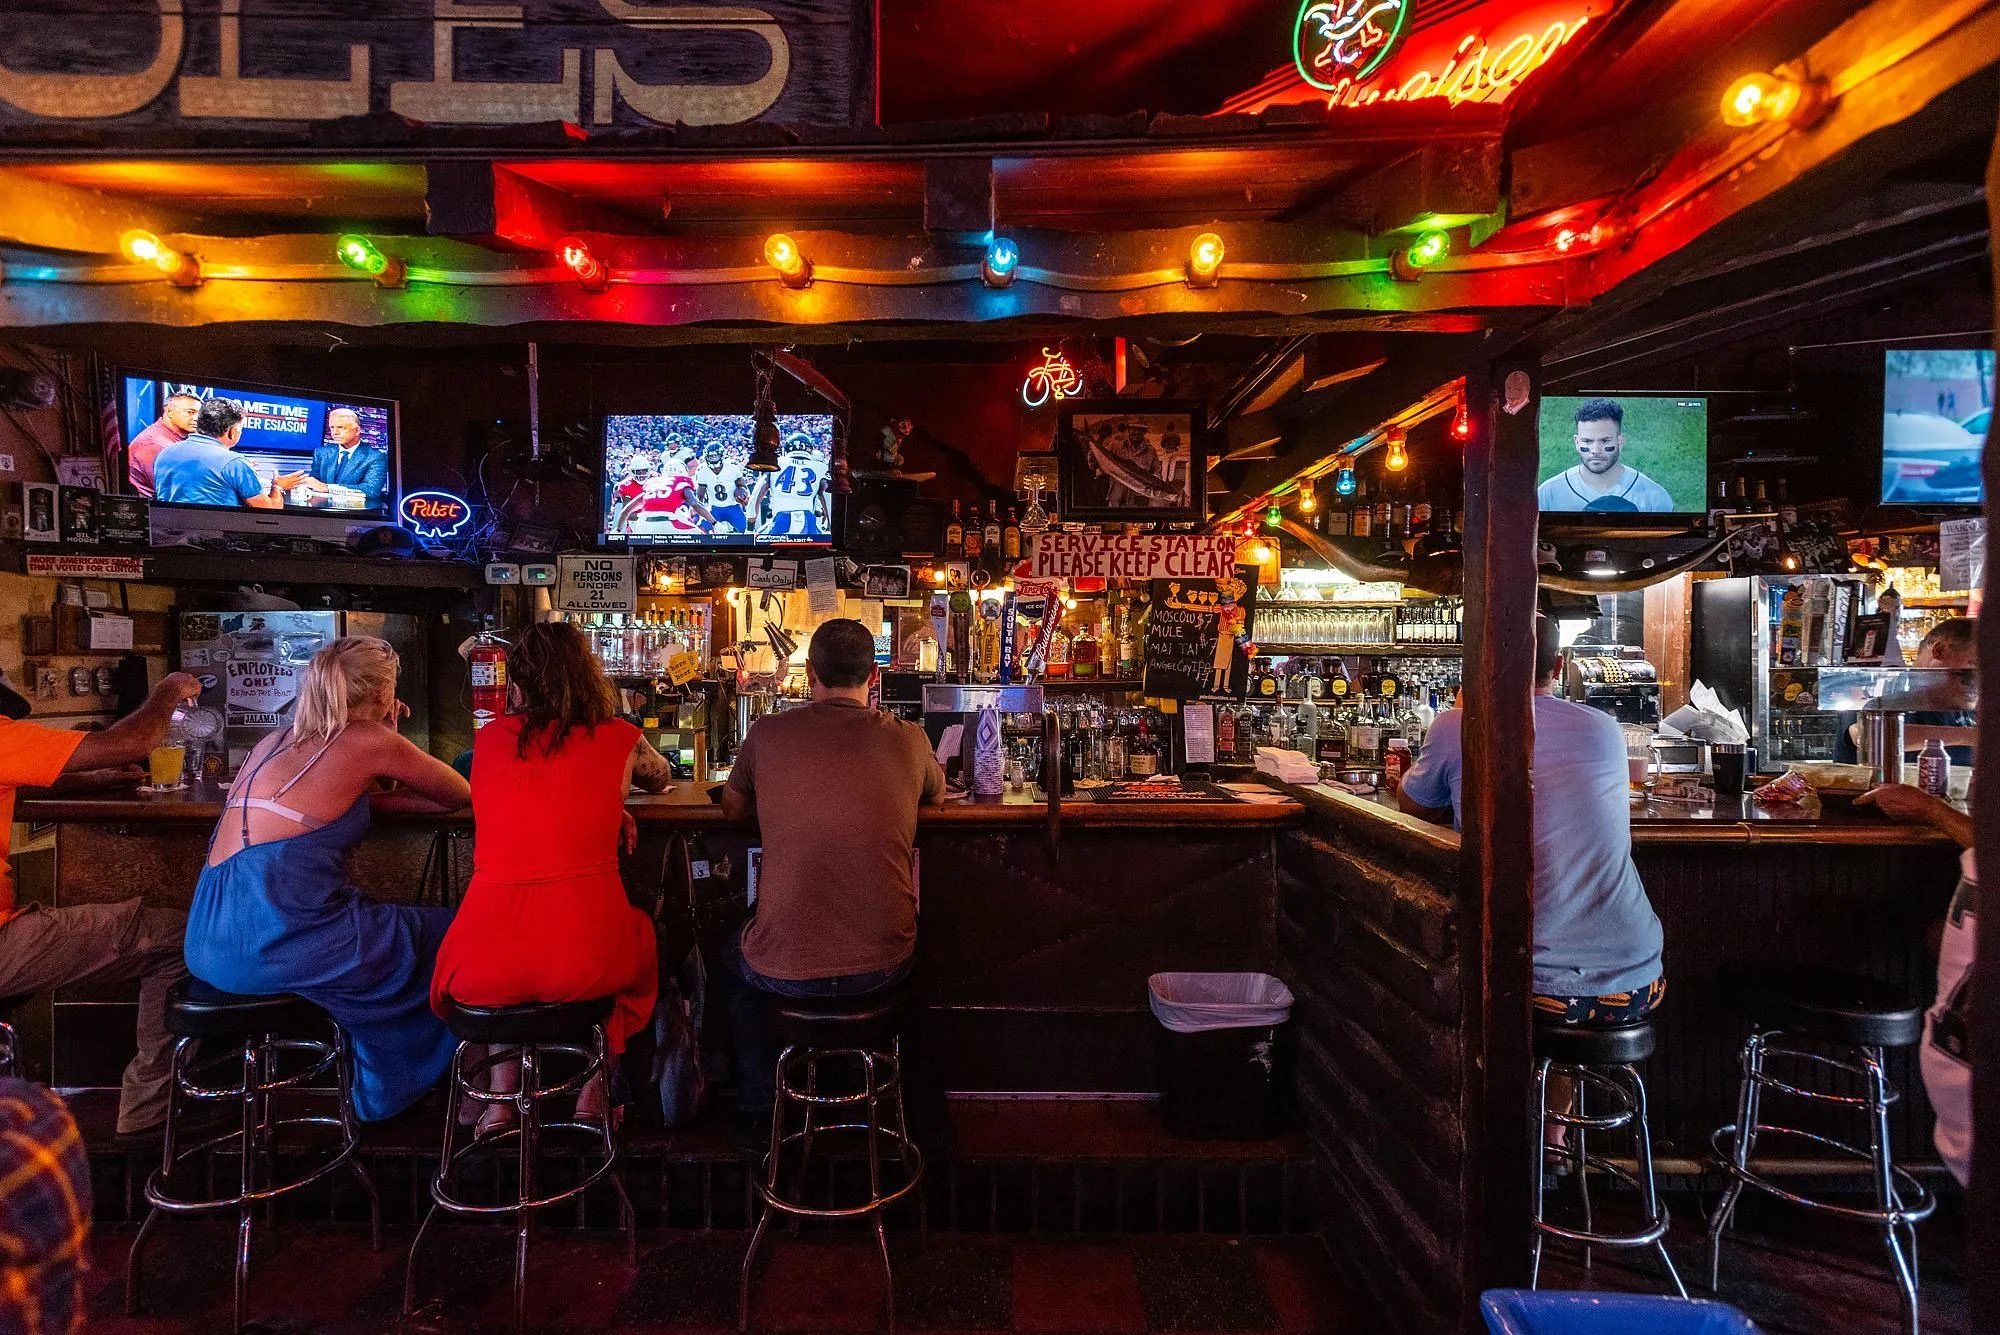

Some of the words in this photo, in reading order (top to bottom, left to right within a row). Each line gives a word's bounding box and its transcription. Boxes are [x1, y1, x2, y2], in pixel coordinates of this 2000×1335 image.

[236, 397, 308, 418] AMETIME
[264, 418, 307, 433] ESIASON
[775, 465, 817, 496] 43
[713, 483, 728, 501] 8
[409, 499, 461, 517] Pabst
[1040, 535, 1140, 551] SERVICE
[1150, 535, 1235, 551] STATION
[29, 563, 53, 571] THAN
[56, 564, 83, 572] VOTED
[30, 556, 56, 564] MORE
[60, 557, 109, 565] AMERICANS
[112, 558, 140, 566] SMOKE
[585, 560, 613, 570] NO
[1038, 551, 1104, 577] PLEASE
[1109, 551, 1160, 577] KEEP
[1164, 551, 1234, 578] CLEAR
[573, 571, 623, 581] PERSONS
[751, 573, 771, 583] Cash
[771, 575, 793, 584] Only
[590, 590, 605, 600] 21
[1153, 610, 1196, 622] MOSCOW
[1005, 608, 1014, 644] SOUTH
[1035, 598, 1060, 660] Budweiser
[1151, 625, 1184, 638] MULE
[1151, 643, 1172, 655] MAI
[1179, 643, 1199, 655] TAI
[1003, 645, 1012, 668] BAY
[227, 661, 293, 677] EMPLOYEES
[242, 677, 276, 688] ONLY
[230, 688, 257, 697] BEYOND
[258, 689, 272, 697] THIS
[245, 714, 276, 724] JALAMA
